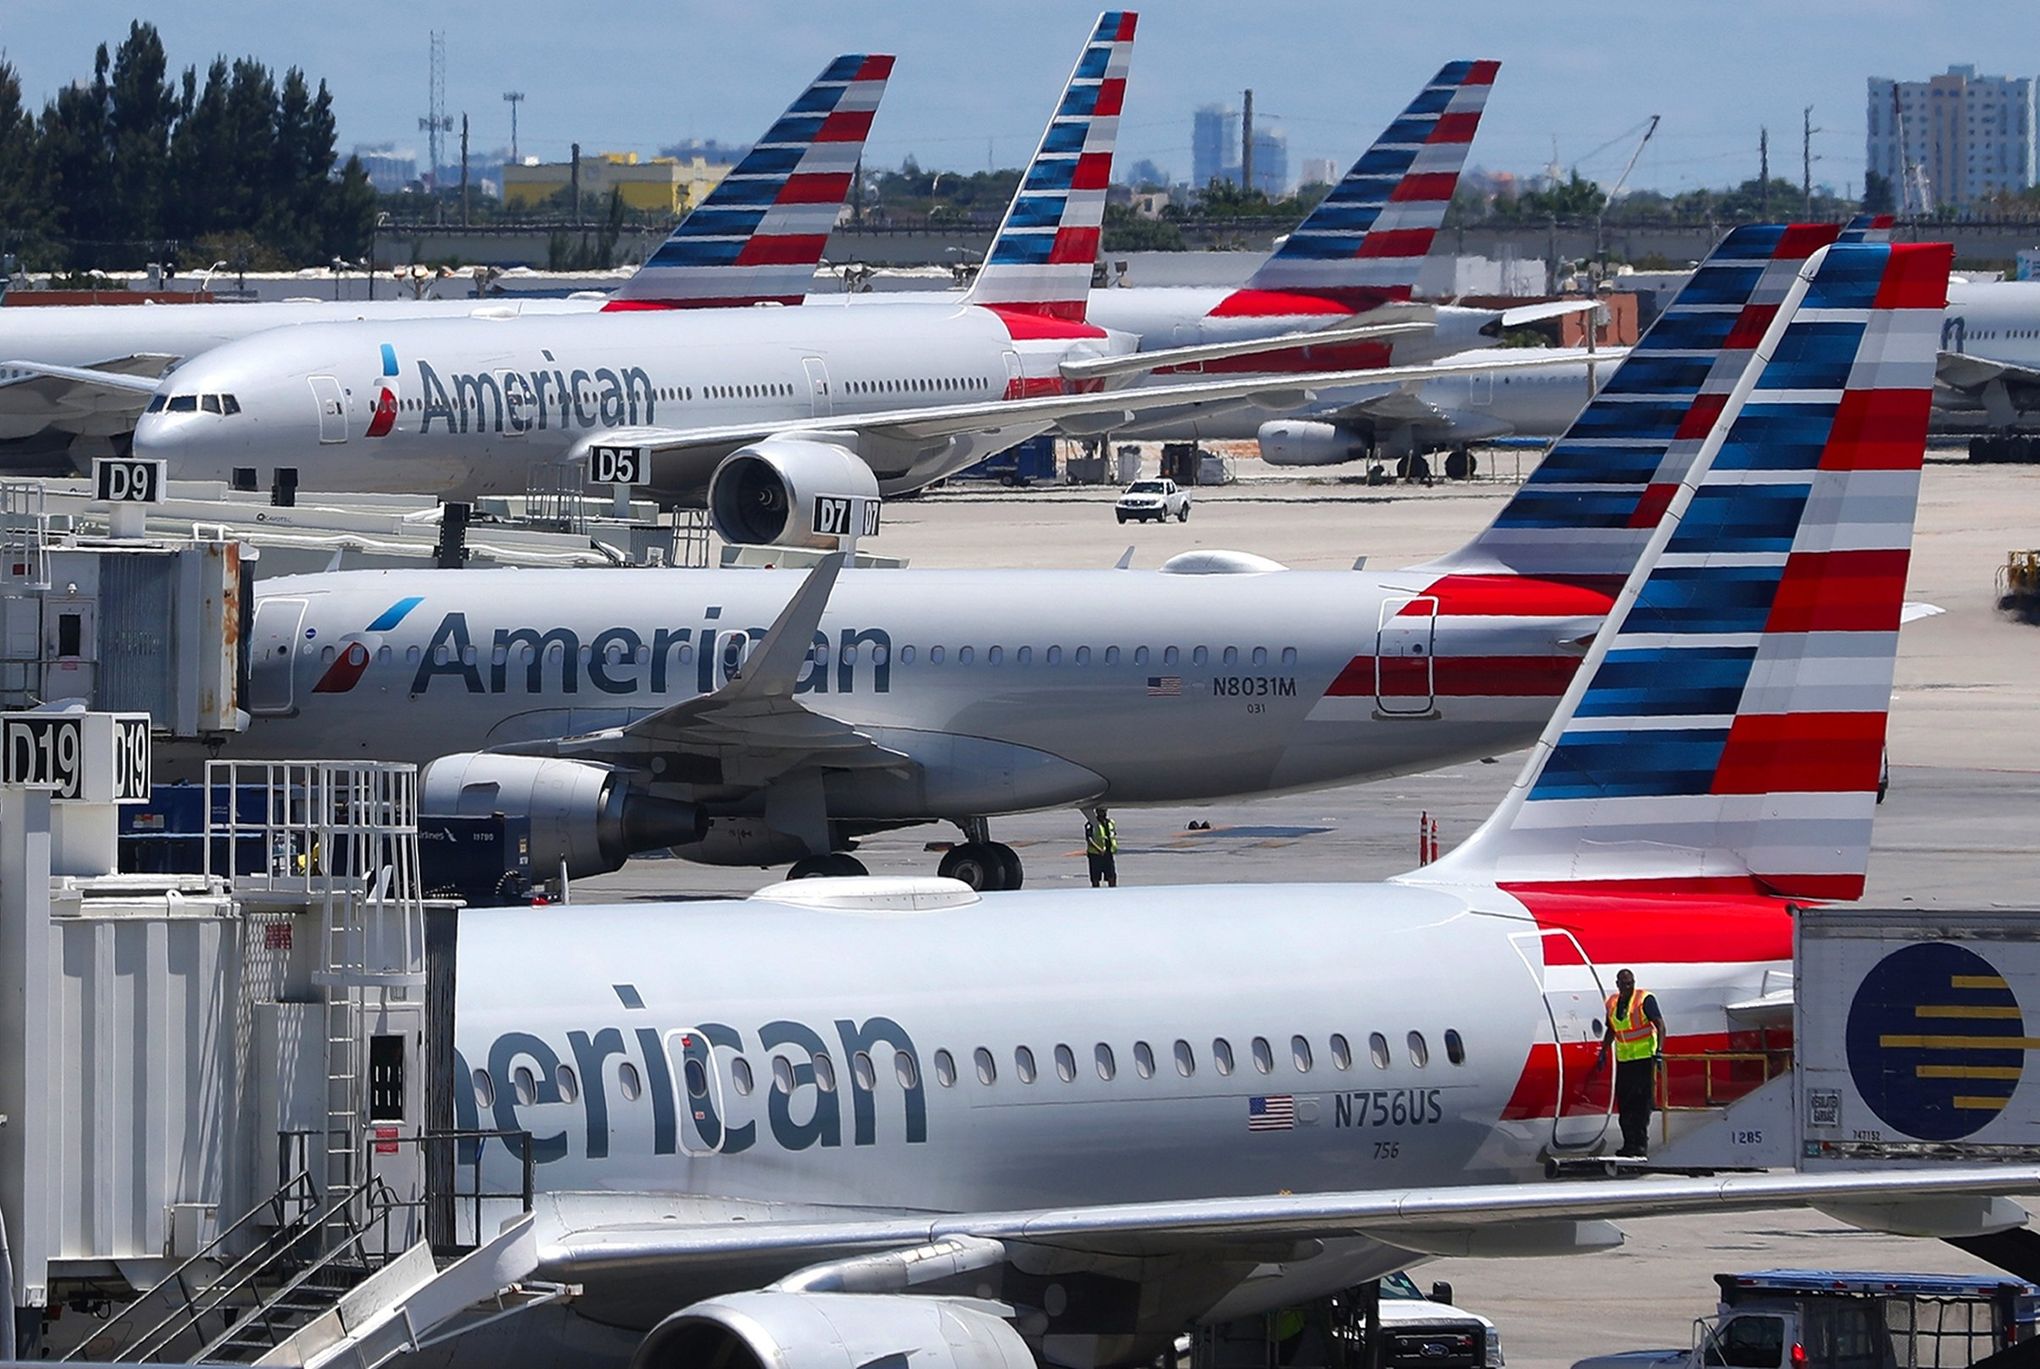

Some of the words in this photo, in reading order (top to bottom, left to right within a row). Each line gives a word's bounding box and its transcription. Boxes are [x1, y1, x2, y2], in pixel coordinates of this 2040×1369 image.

[417, 350, 654, 434] American
[109, 464, 149, 500] D9
[599, 450, 634, 482] D5
[820, 498, 847, 534] D7
[864, 501, 879, 535] D7
[1213, 677, 1297, 696] N8031M
[1246, 704, 1266, 714] 031
[8, 723, 81, 799] D19
[116, 723, 148, 798] D19
[455, 984, 927, 1165] erican
[1334, 1090, 1442, 1128] N756US
[1373, 1141, 1400, 1160] 756
[1731, 1131, 1762, 1144] 1285
